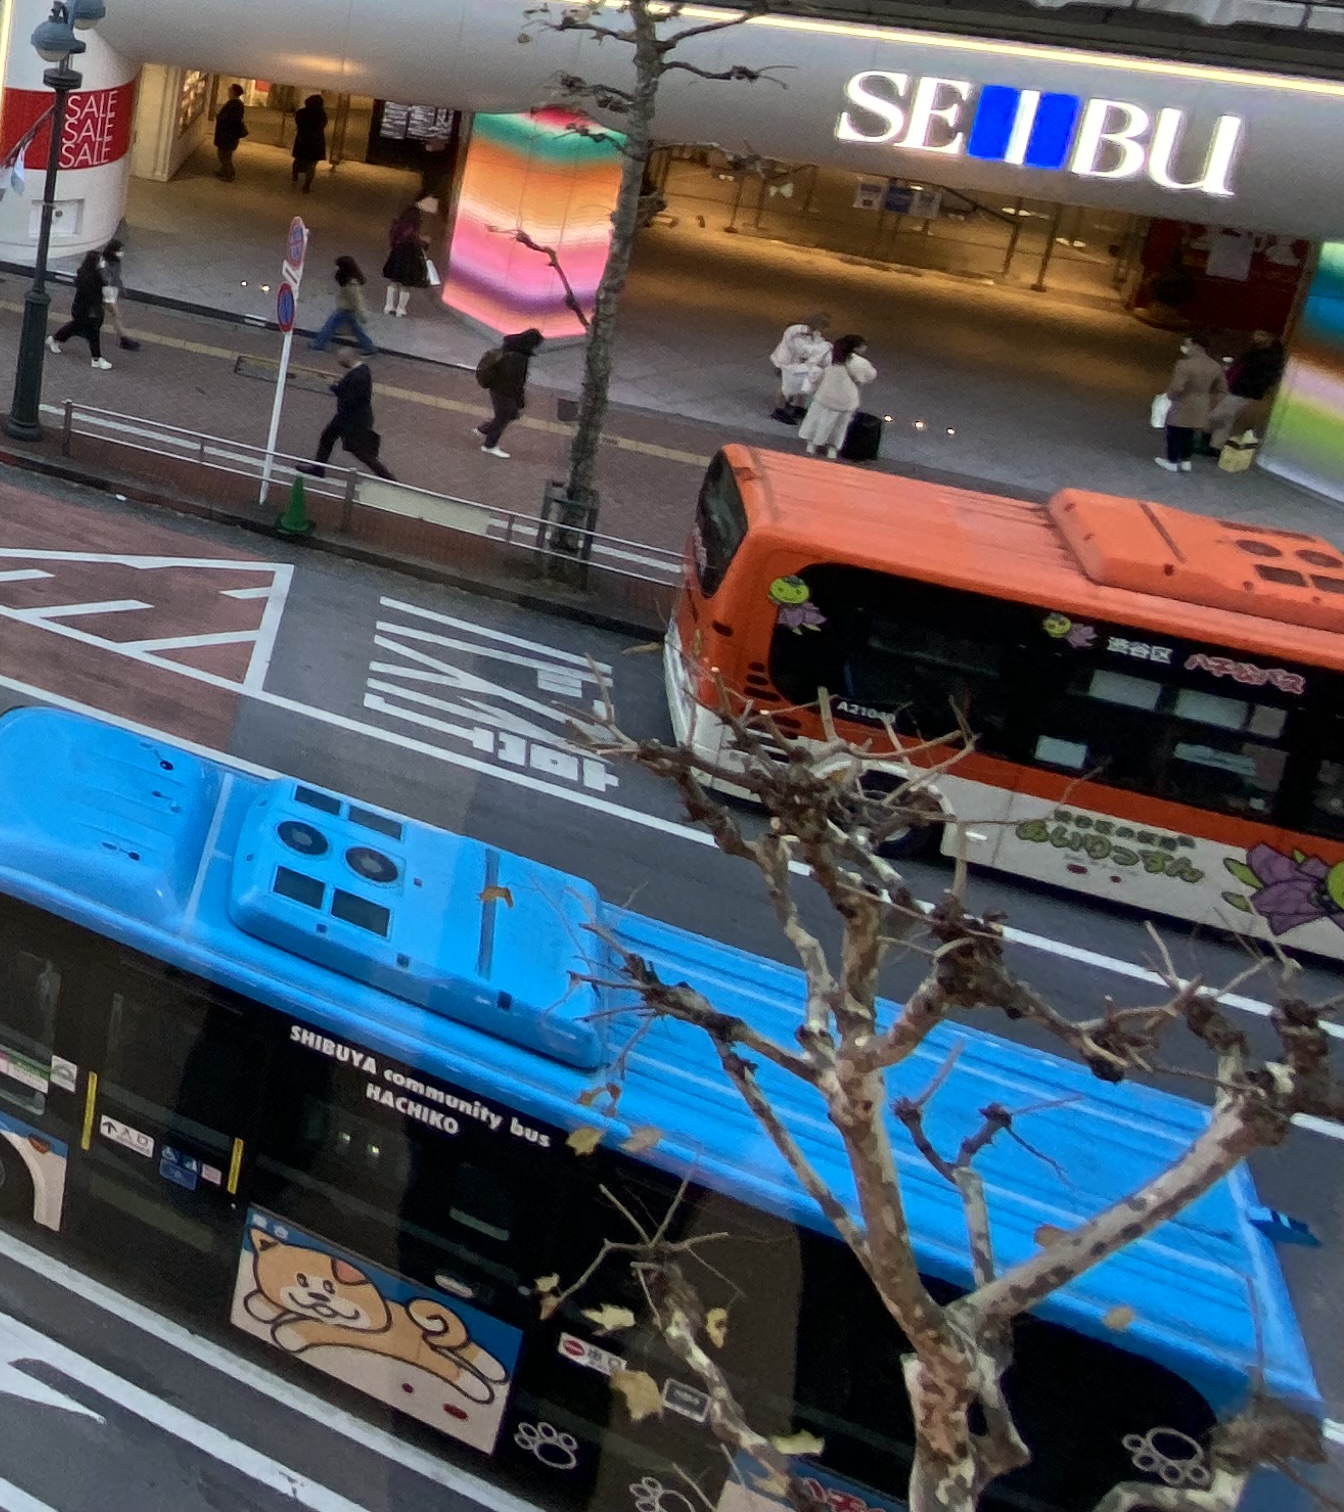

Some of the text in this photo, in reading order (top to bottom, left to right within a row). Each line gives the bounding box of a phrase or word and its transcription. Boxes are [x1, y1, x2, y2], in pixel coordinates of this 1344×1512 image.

[64, 90, 119, 121] SALE
[61, 115, 115, 145] SALE
[833, 70, 1243, 197] SEIBU
[58, 141, 112, 169] SALE
[1107, 637, 1174, 664] 渋谷区
[290, 1024, 551, 1148] SHIBUYA community bus
[365, 1083, 460, 1135] HACHIKO
